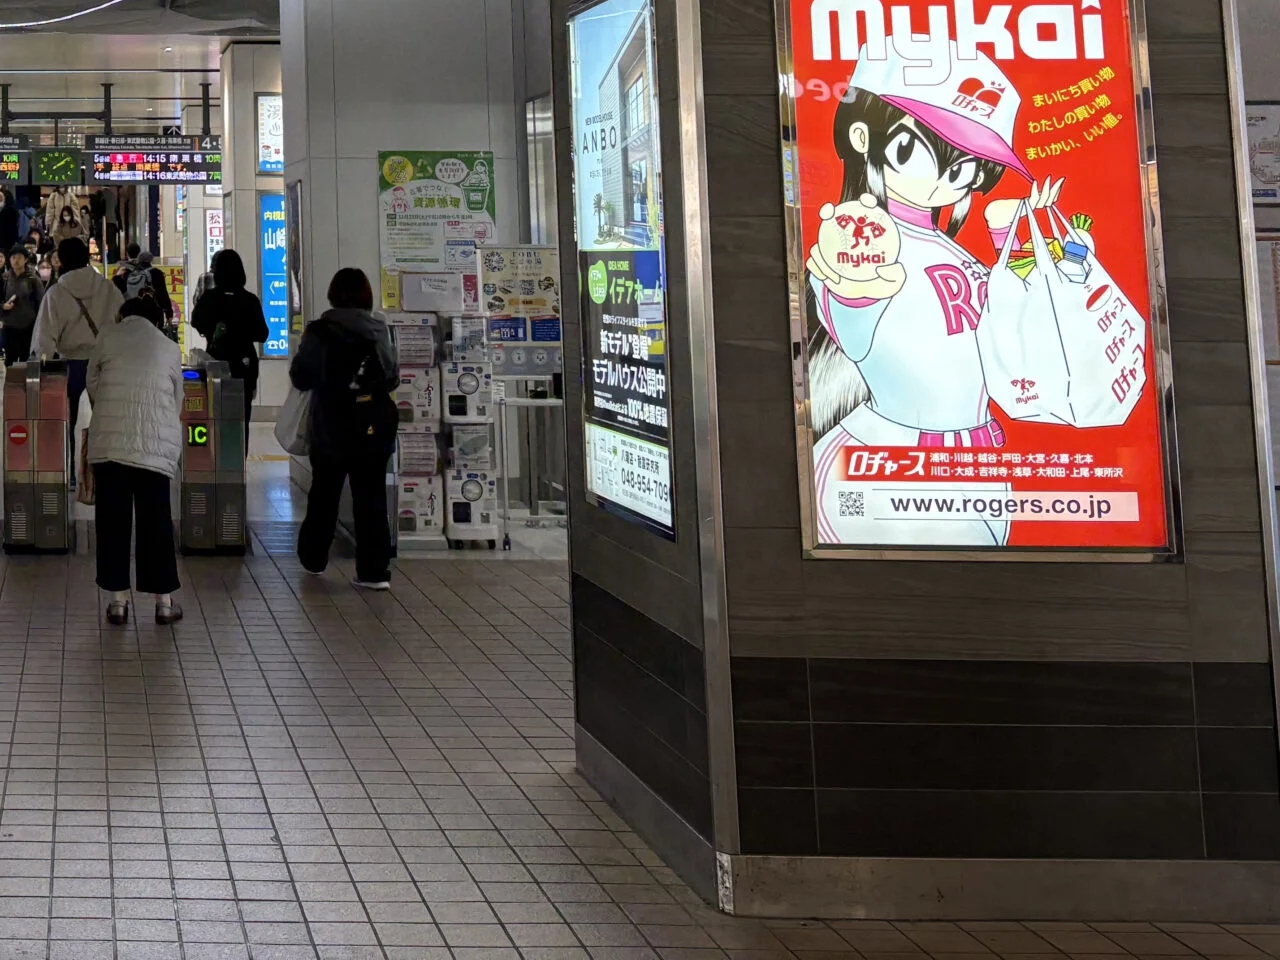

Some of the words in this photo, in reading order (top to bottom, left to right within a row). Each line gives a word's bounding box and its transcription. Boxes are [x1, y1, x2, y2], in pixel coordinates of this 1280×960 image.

[1032, 66, 1115, 108] まいにち買い物
[951, 94, 996, 120] ロヂャース
[1027, 94, 1111, 133] わたしの買い物
[583, 125, 617, 155] ANBO
[1025, 113, 1123, 160] まいかい、いい値。
[143, 154, 166, 163] 14:15
[143, 171, 165, 180] 14:16
[837, 251, 886, 268] Mykai
[609, 276, 661, 305] イデアホーム
[1097, 297, 1127, 333] ロヂャース
[1105, 319, 1135, 364] ロヂャース
[592, 359, 666, 400] モデルハウス公開中
[1015, 393, 1040, 405] Mykai
[188, 426, 208, 443] IC
[847, 451, 925, 476] ロヂャース
[621, 467, 670, 502] 048-954-709
[890, 495, 1112, 518] www.rogers.co.jp
